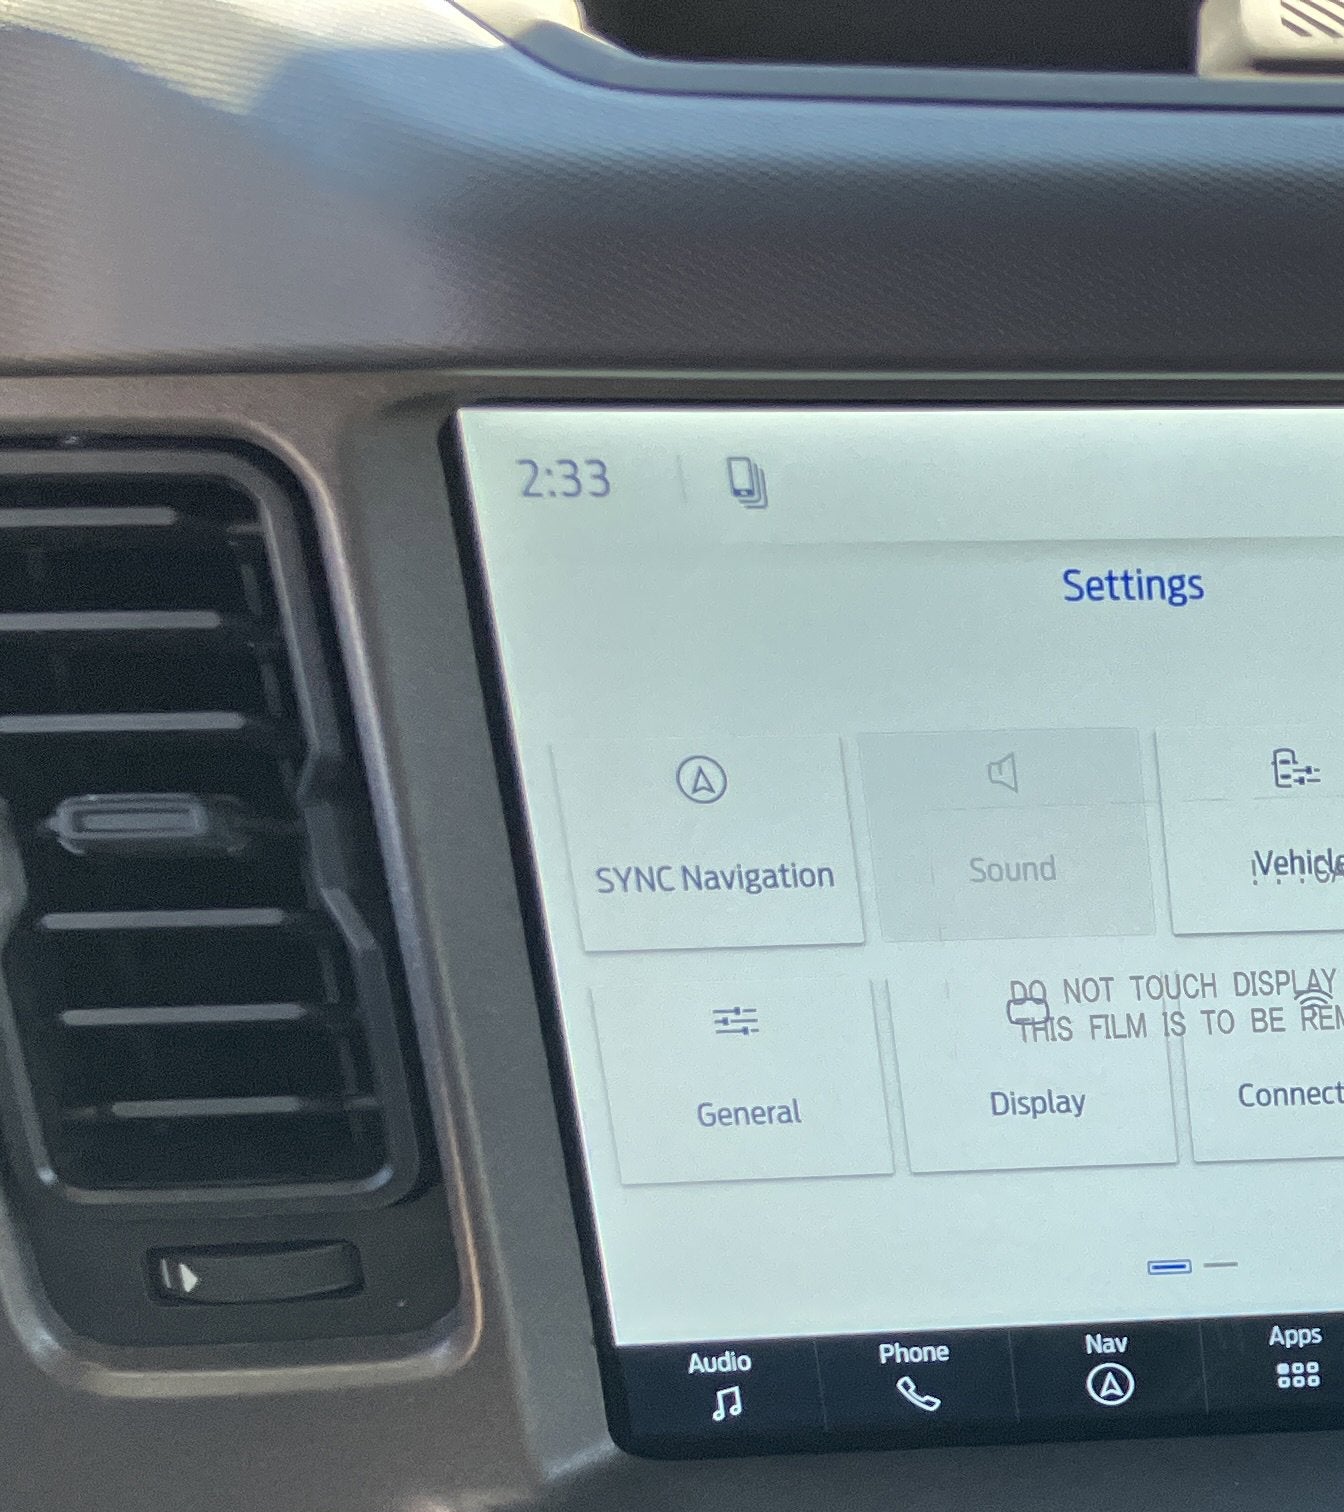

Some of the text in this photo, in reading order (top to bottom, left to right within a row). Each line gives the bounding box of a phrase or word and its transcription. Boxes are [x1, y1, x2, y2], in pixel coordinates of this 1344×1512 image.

[515, 458, 612, 499] 2:33
[1063, 567, 1205, 606] Settings
[595, 860, 835, 898] SYNC Navigation
[968, 854, 1058, 884] Sound
[1009, 979, 1048, 1005] DO
[1063, 976, 1115, 1004] NOT
[1129, 972, 1218, 1001] TOUCH
[1233, 968, 1337, 998] DISPLAY
[1015, 1015, 1074, 1043] THIS
[1089, 1012, 1148, 1040] FILM
[1162, 1011, 1187, 1038] IS
[1200, 1009, 1236, 1036] TO
[1250, 1007, 1287, 1034] BE
[696, 1097, 803, 1128] General
[989, 1089, 1087, 1119] Display
[1084, 1332, 1129, 1356] Nav
[1268, 1324, 1324, 1350] Apps
[687, 1349, 753, 1376] Audio
[878, 1340, 951, 1366] Phone
